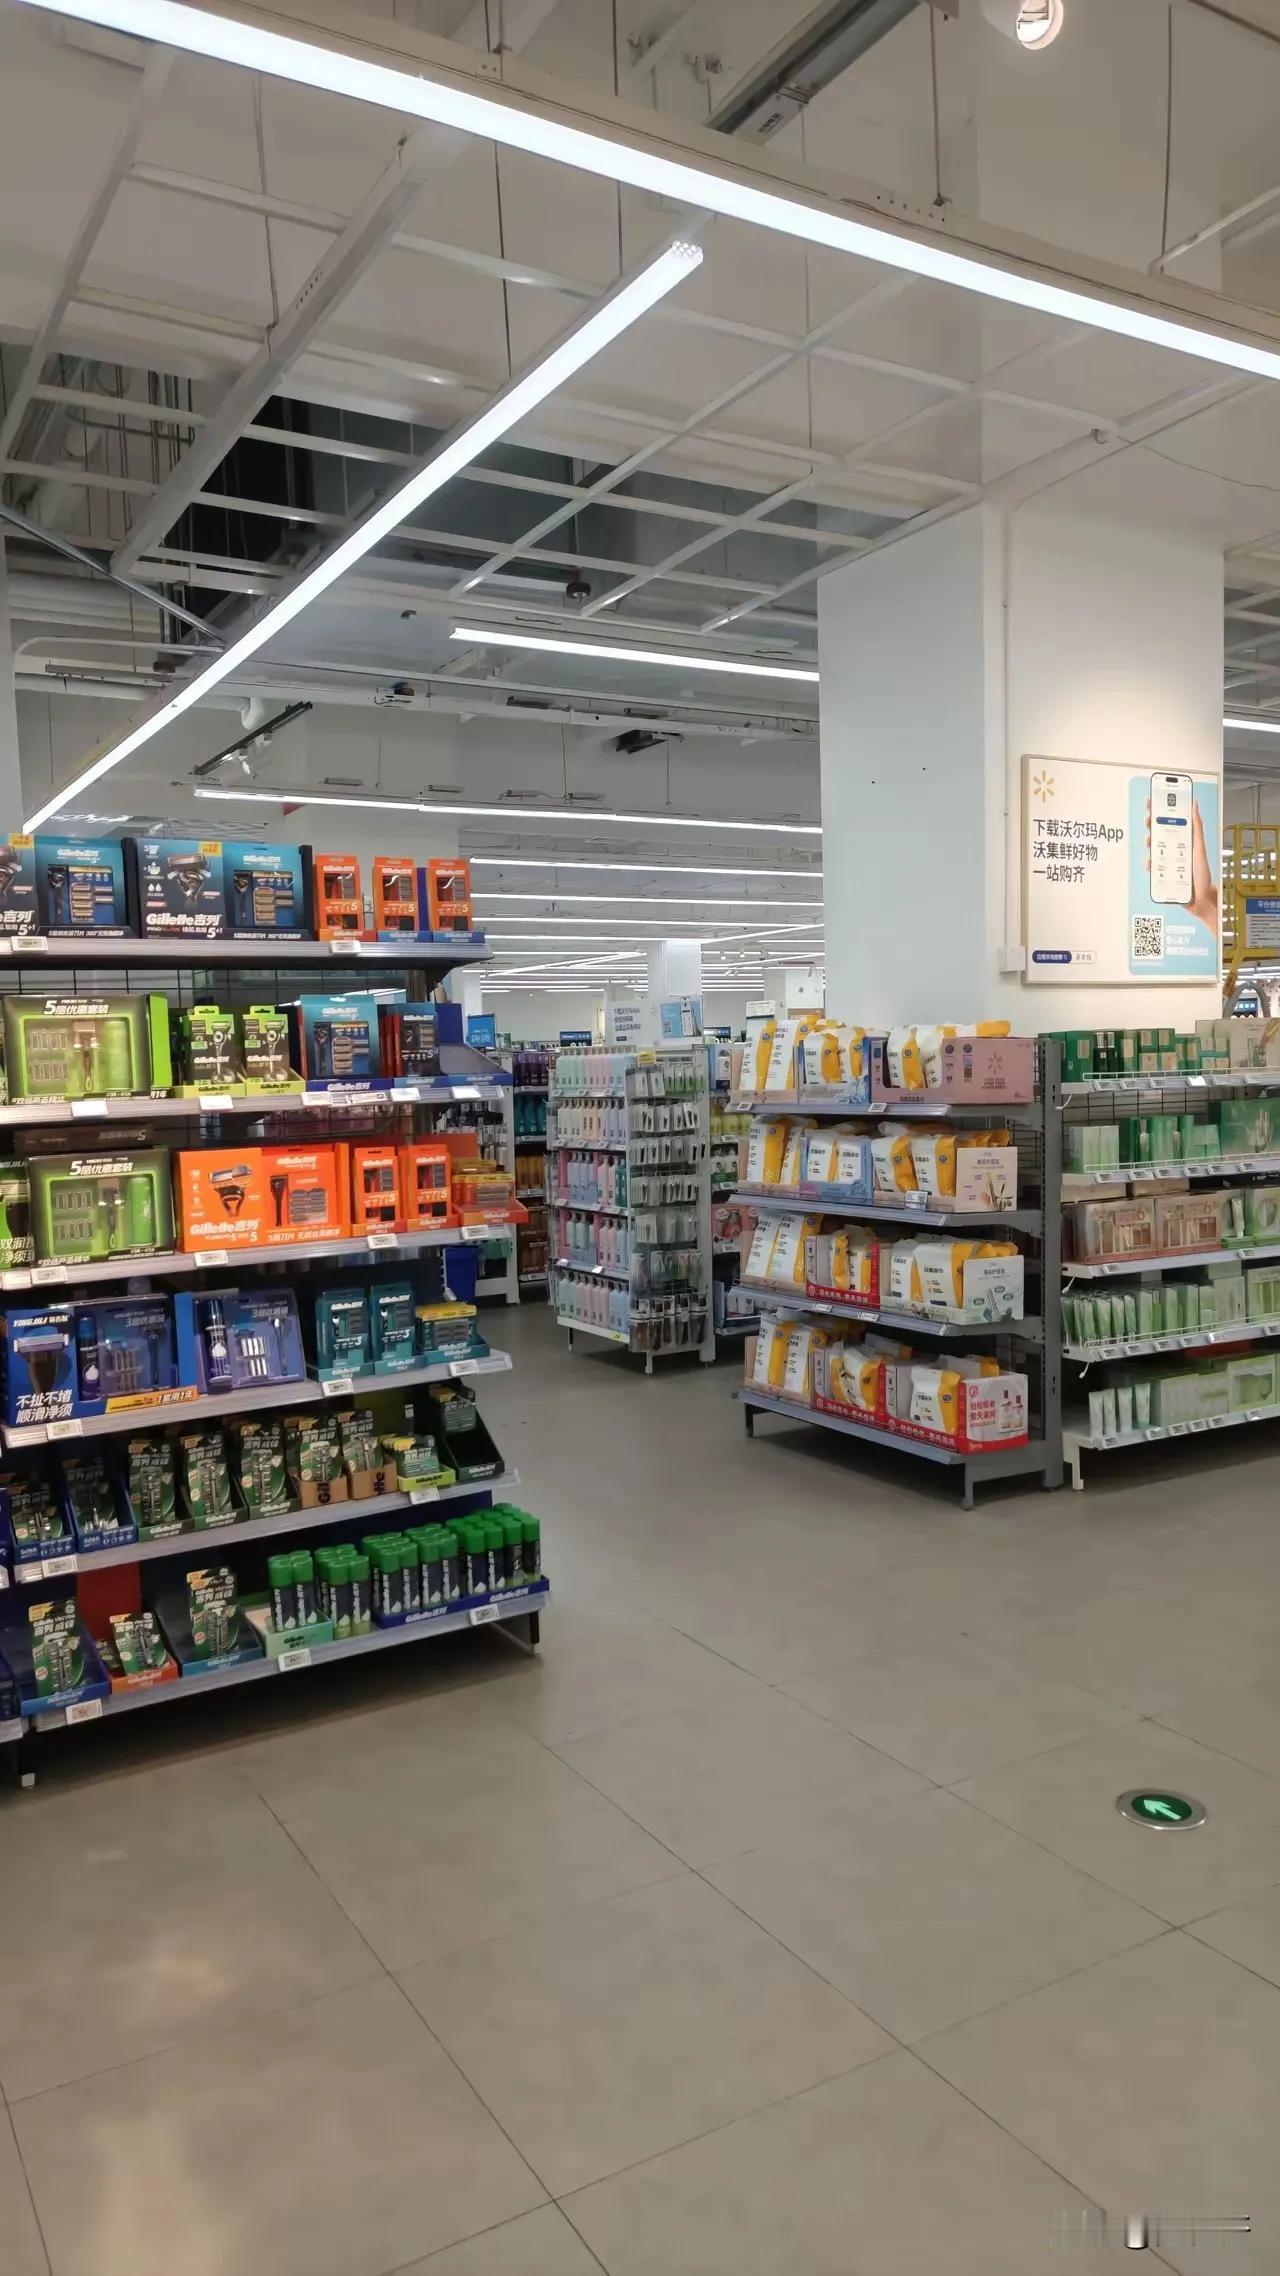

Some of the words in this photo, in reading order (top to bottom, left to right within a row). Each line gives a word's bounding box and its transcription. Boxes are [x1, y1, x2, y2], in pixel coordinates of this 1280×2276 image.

[1032, 818, 1124, 843] 下载沃尔玛App
[1032, 840, 1099, 862] 沃集鲜好物
[1032, 863, 1085, 883] 一站购齐
[146, 913, 222, 926] Gillette吉列
[69, 1160, 134, 1177] 5层优惠套装
[15, 1389, 73, 1409] 不扯不堵
[15, 1403, 74, 1424] 顺滑净须
